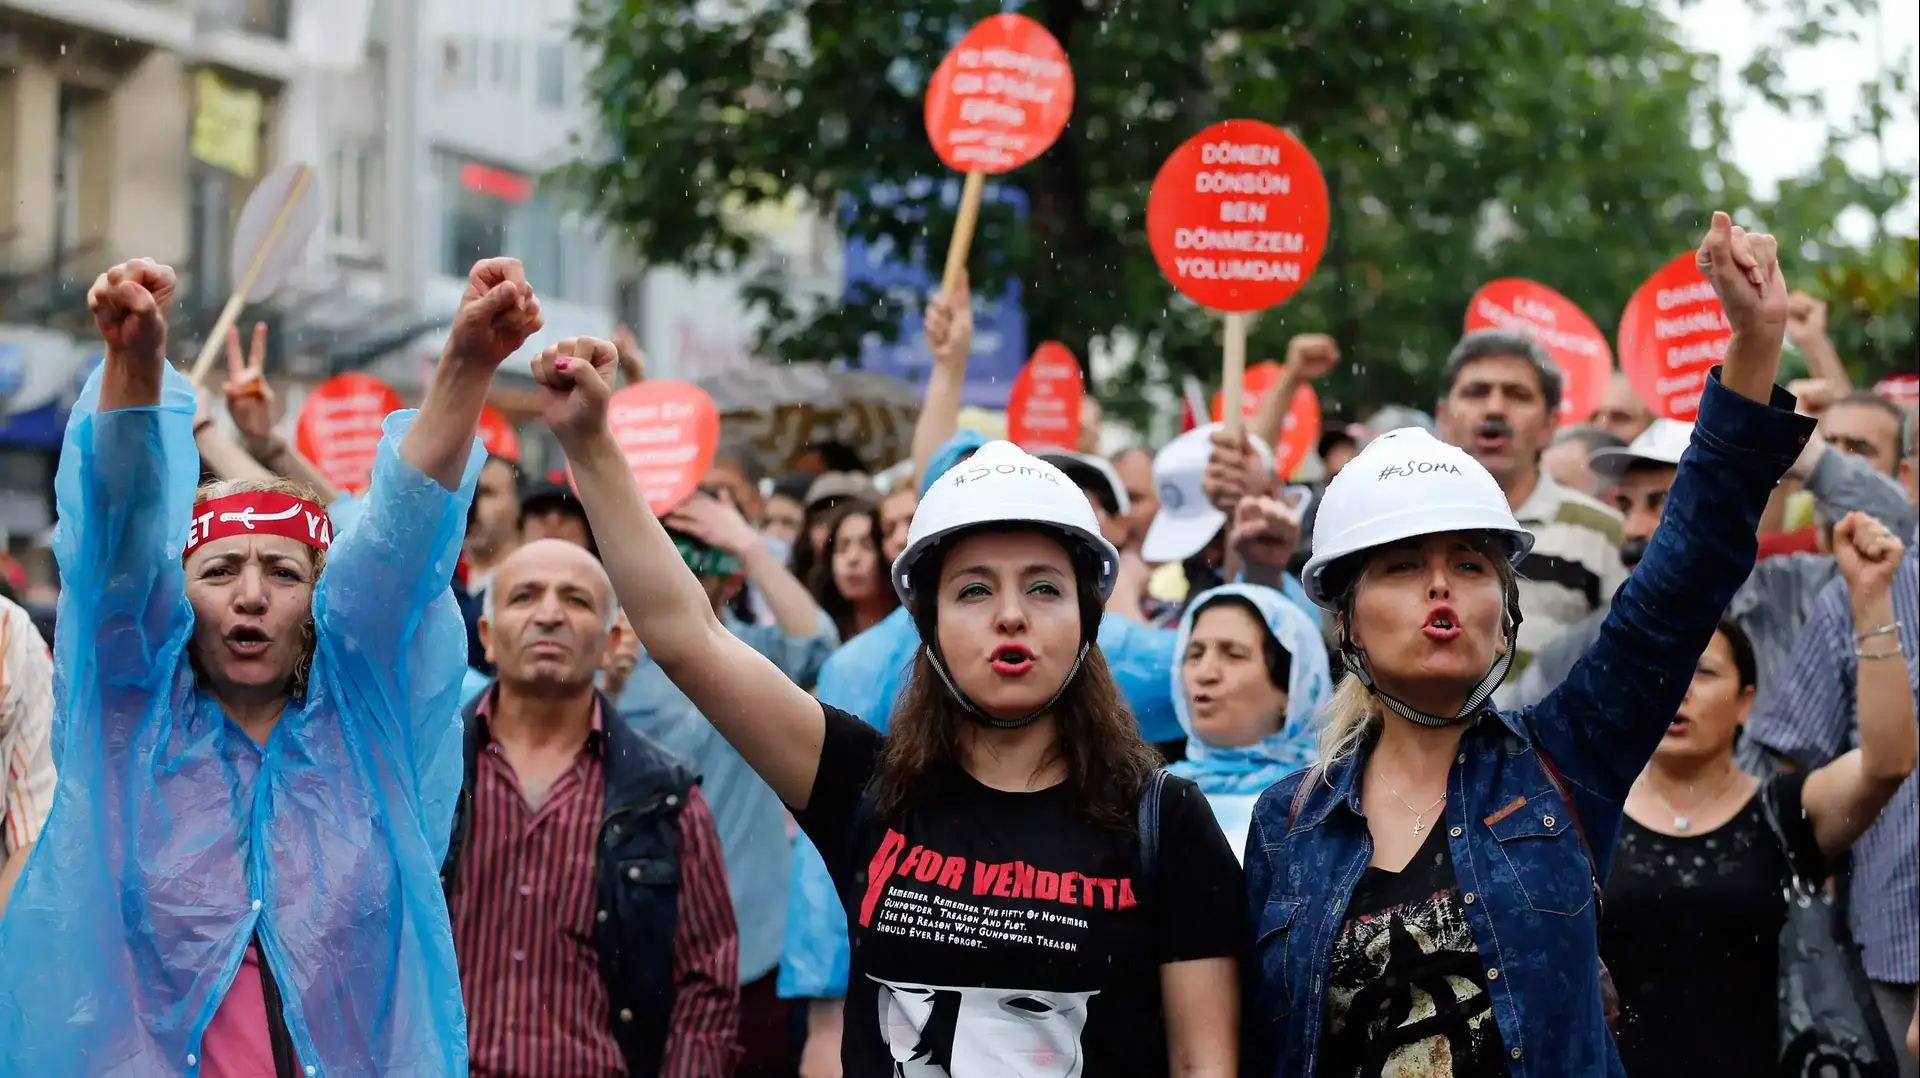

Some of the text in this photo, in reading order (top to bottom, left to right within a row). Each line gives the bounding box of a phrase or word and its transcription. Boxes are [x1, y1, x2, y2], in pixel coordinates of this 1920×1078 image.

[1202, 142, 1280, 166] DÖNEN
[1196, 170, 1290, 195] DÖNSÜN
[1220, 201, 1267, 223] BEN
[1174, 226, 1303, 253] DÖNMEZEM
[1174, 256, 1301, 282] YOLUMDAN
[1378, 460, 1462, 481] #SOMA
[182, 511, 214, 555] ET
[897, 845, 966, 890] FOR
[972, 860, 1137, 911] VENDETTA
